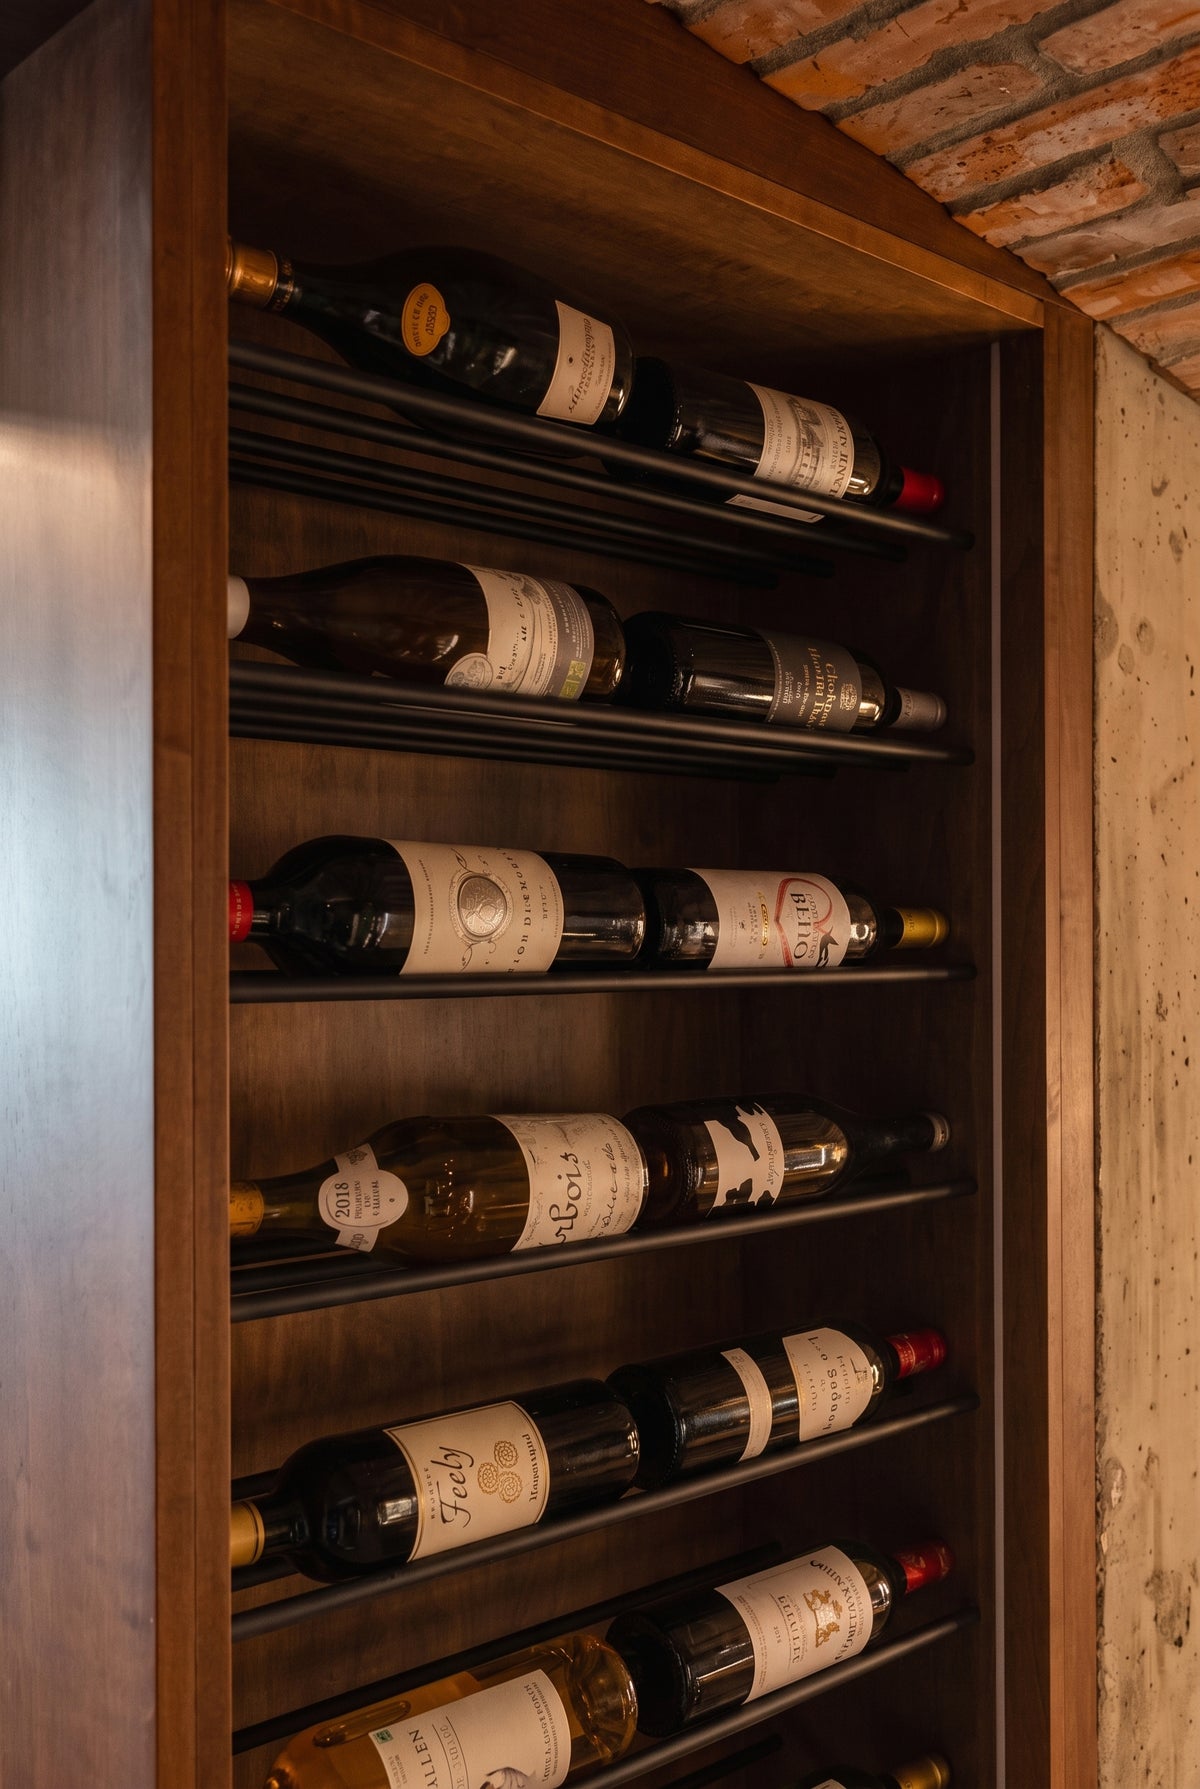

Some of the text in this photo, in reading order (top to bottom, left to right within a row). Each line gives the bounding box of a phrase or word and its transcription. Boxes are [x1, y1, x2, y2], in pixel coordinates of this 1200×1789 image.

[335, 1182, 350, 1218] 2018
[540, 1151, 582, 1246] rbois
[430, 1446, 474, 1528] Feely
